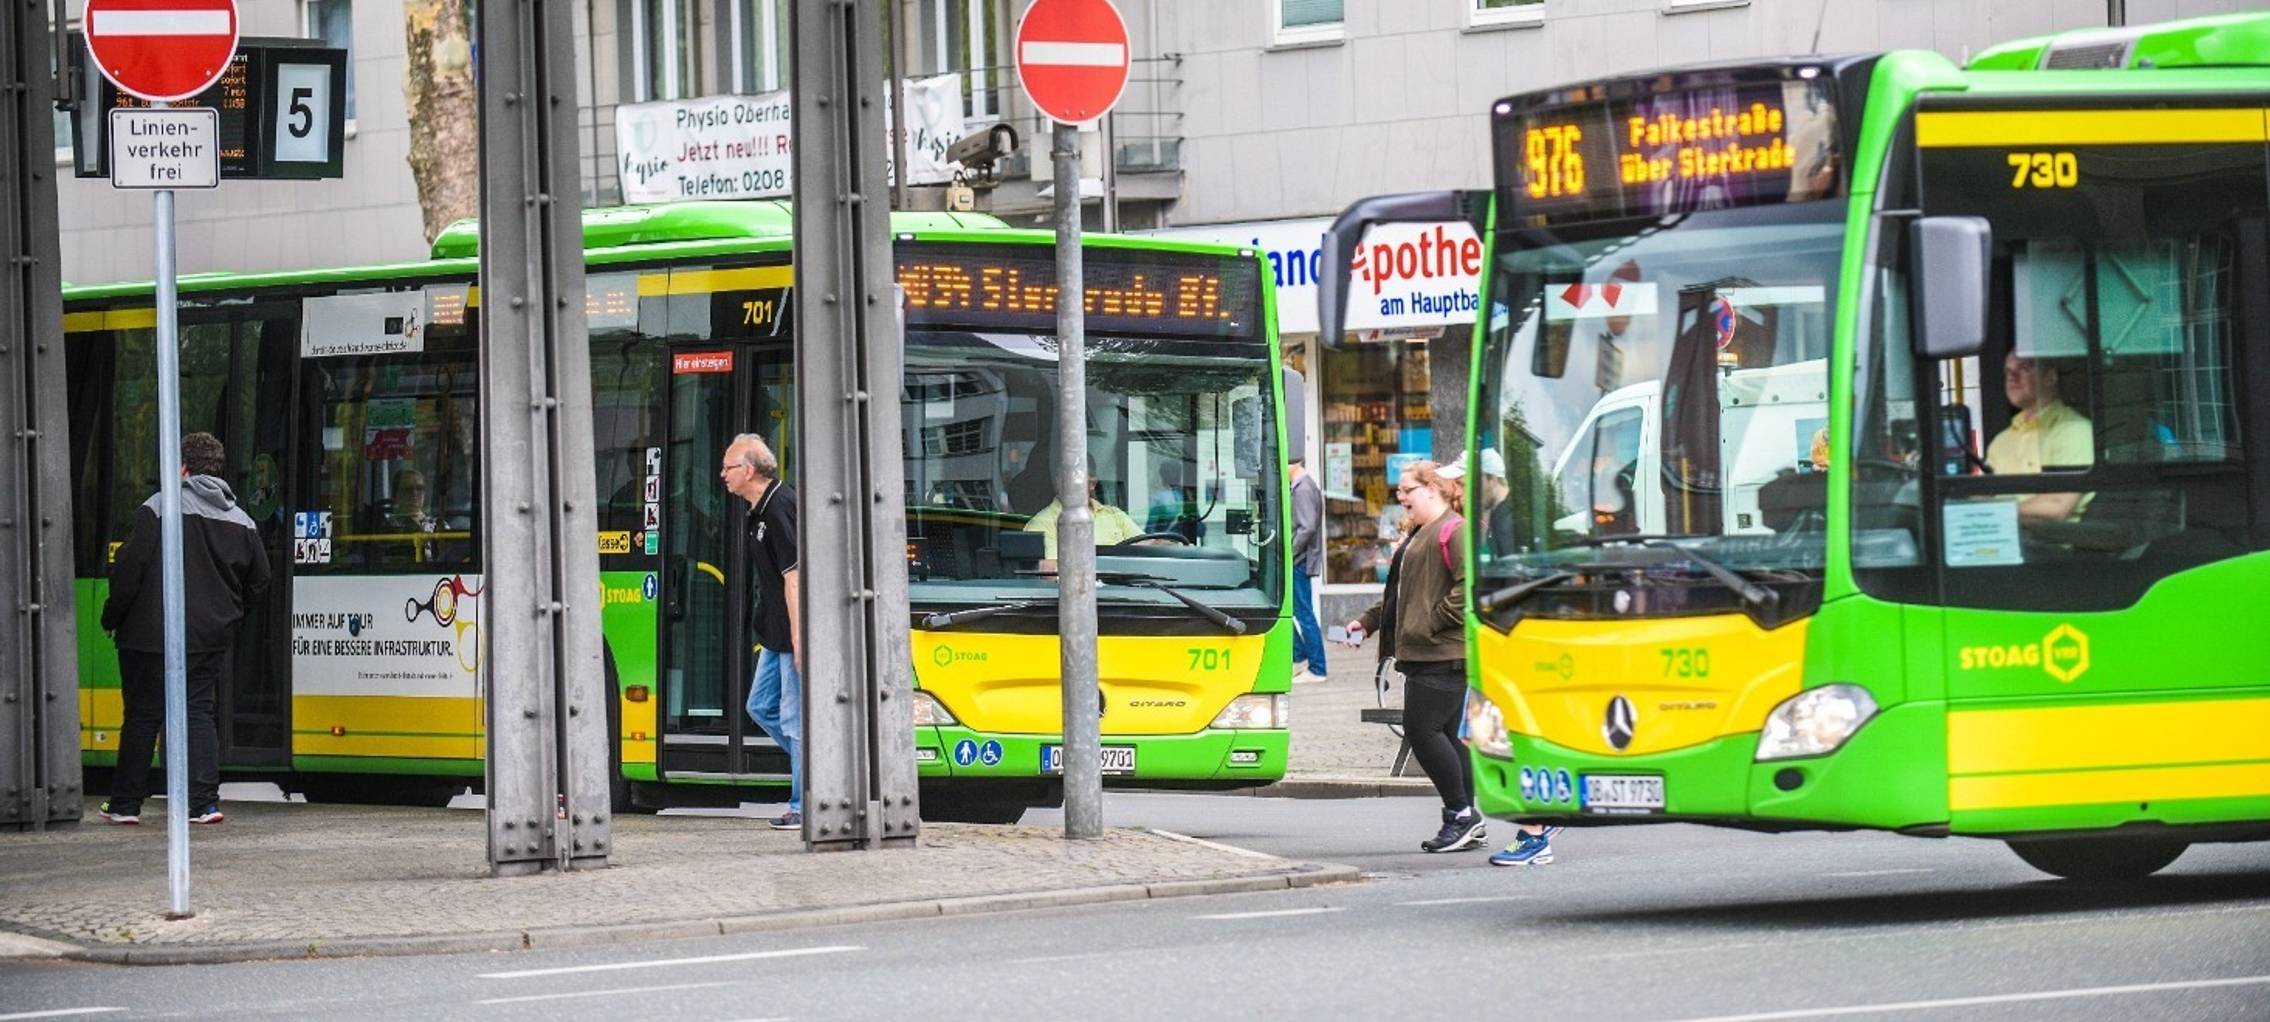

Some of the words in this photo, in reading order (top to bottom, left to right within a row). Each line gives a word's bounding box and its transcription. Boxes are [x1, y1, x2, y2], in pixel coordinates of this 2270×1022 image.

[288, 87, 313, 138] 5
[677, 105, 728, 131] Physio
[131, 119, 198, 136] Linien-
[127, 141, 203, 158] verkehr
[677, 140, 719, 163] Jetzt
[726, 136, 769, 158] neu!!!
[1525, 124, 1585, 198] 976
[1628, 102, 1783, 147] Falkestraße
[1620, 153, 1672, 184] über
[1678, 137, 1795, 177] Sterkrade
[150, 163, 182, 180] frei
[678, 173, 738, 196] Telefon:
[742, 169, 784, 191] 0208
[2007, 152, 2078, 188] 730
[742, 301, 773, 325] 701
[1380, 297, 1404, 316] am
[607, 588, 641, 603] STOAG
[292, 613, 325, 629] IMMER
[327, 613, 344, 629] AUF
[292, 636, 310, 656] FÜR
[313, 640, 332, 656] EINE
[334, 640, 372, 656] BESSERE
[374, 640, 454, 656] INFRASTRUKTUR.
[1960, 643, 2040, 670] STOAG
[1187, 648, 1231, 671] 701
[1660, 648, 1709, 678] 730
